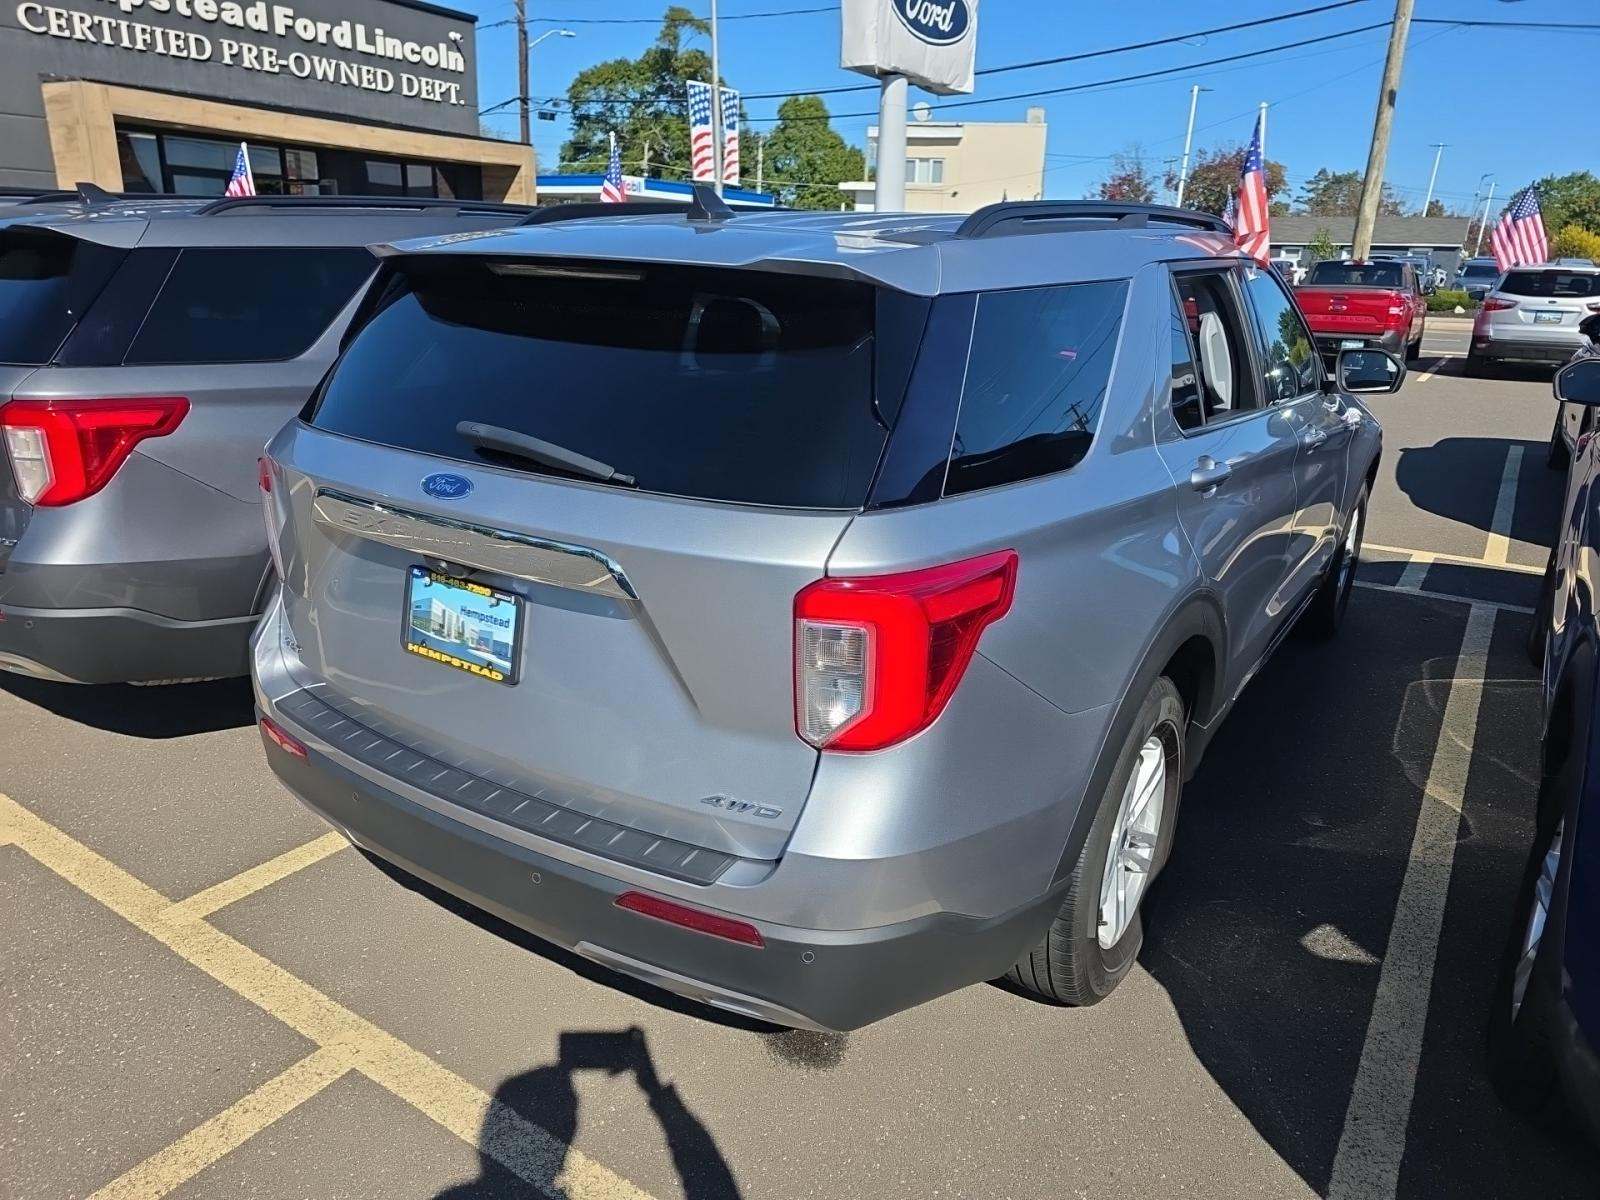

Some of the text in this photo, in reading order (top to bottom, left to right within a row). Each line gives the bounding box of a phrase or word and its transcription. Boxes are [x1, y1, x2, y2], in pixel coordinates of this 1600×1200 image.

[16, 2, 465, 105] CERTIFIED PRE-OWNED DEPT.
[272, 5, 353, 50] Ford
[354, 23, 465, 73] Lincoln
[460, 604, 511, 629] Hempstead
[407, 642, 504, 681] HEMPSTEAD
[700, 795, 783, 819] 4WD
